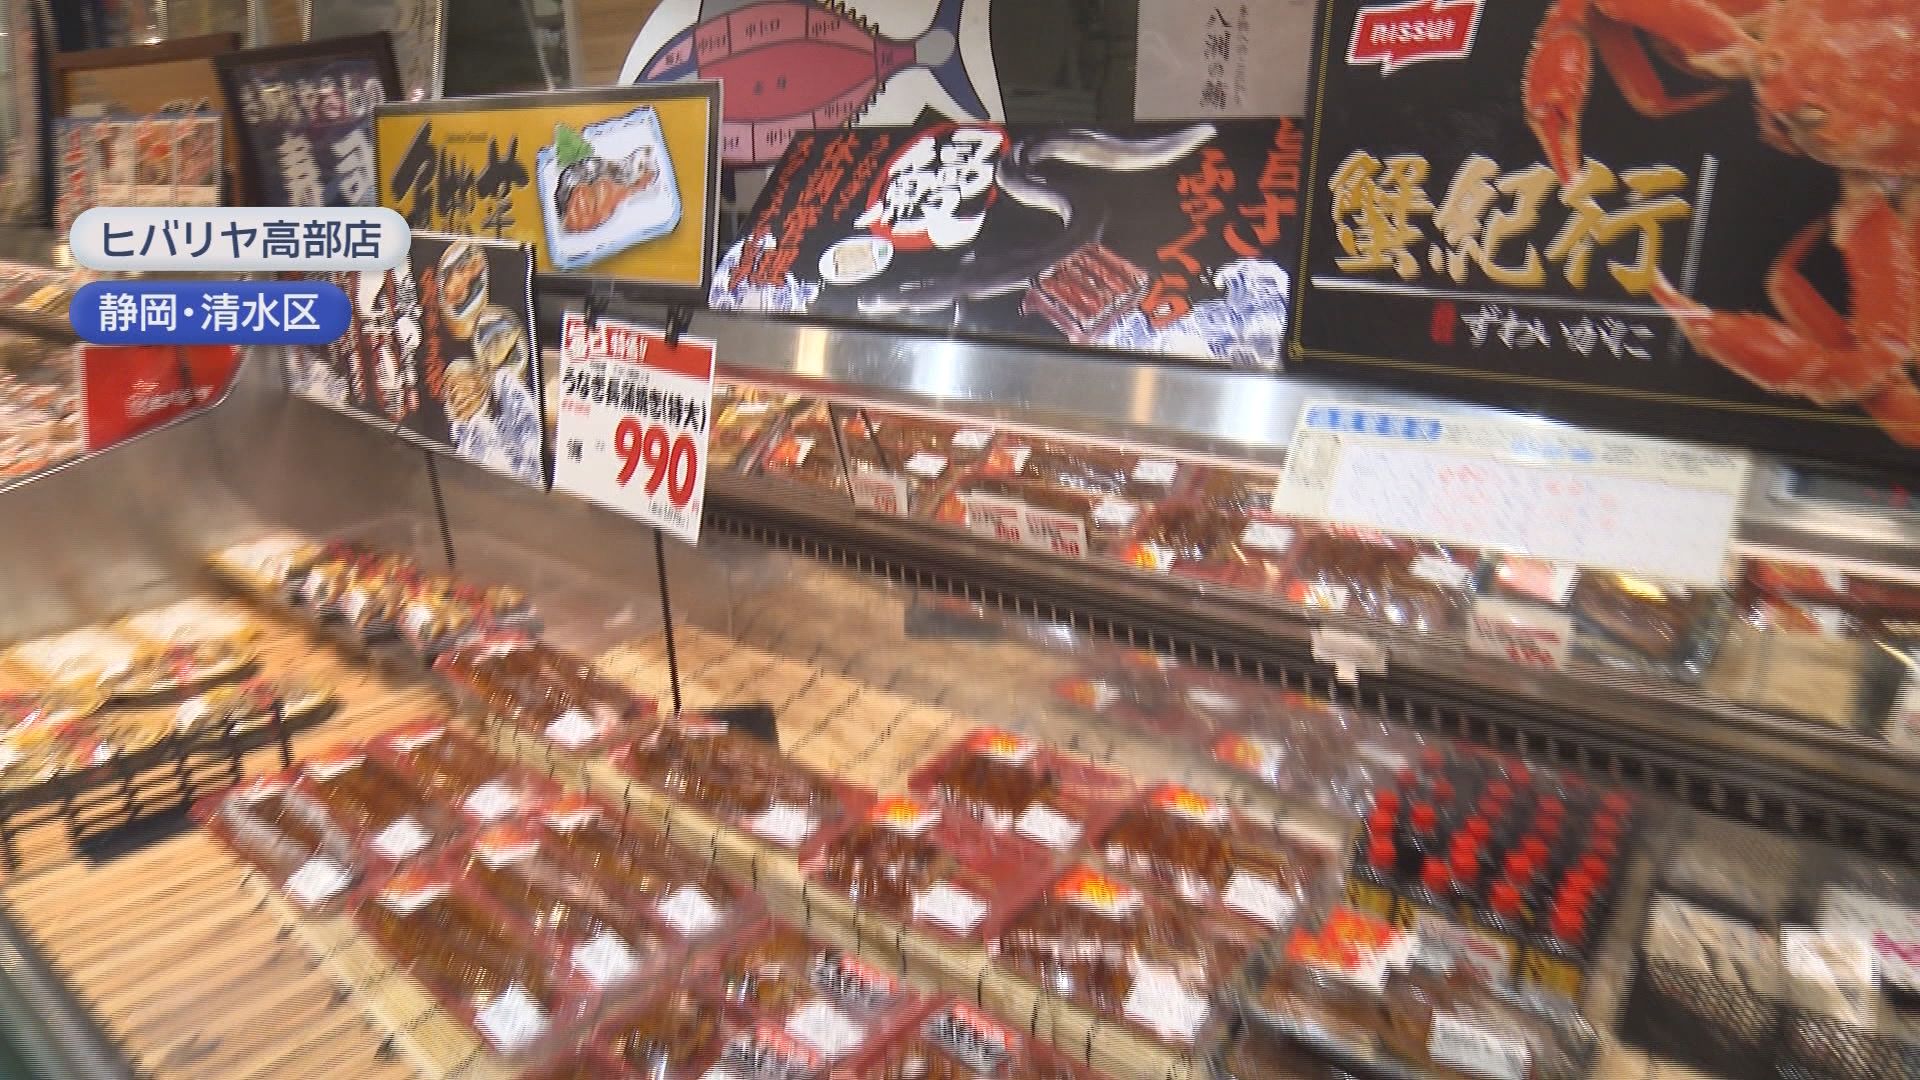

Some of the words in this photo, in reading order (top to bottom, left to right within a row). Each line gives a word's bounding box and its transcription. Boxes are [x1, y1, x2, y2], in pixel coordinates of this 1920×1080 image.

[1327, 149, 1692, 294] 蟹紀行
[1461, 304, 1655, 359] ずわいがに
[562, 366, 707, 434] うなぎ長蒲焼き(特大)
[614, 415, 698, 511] 990
